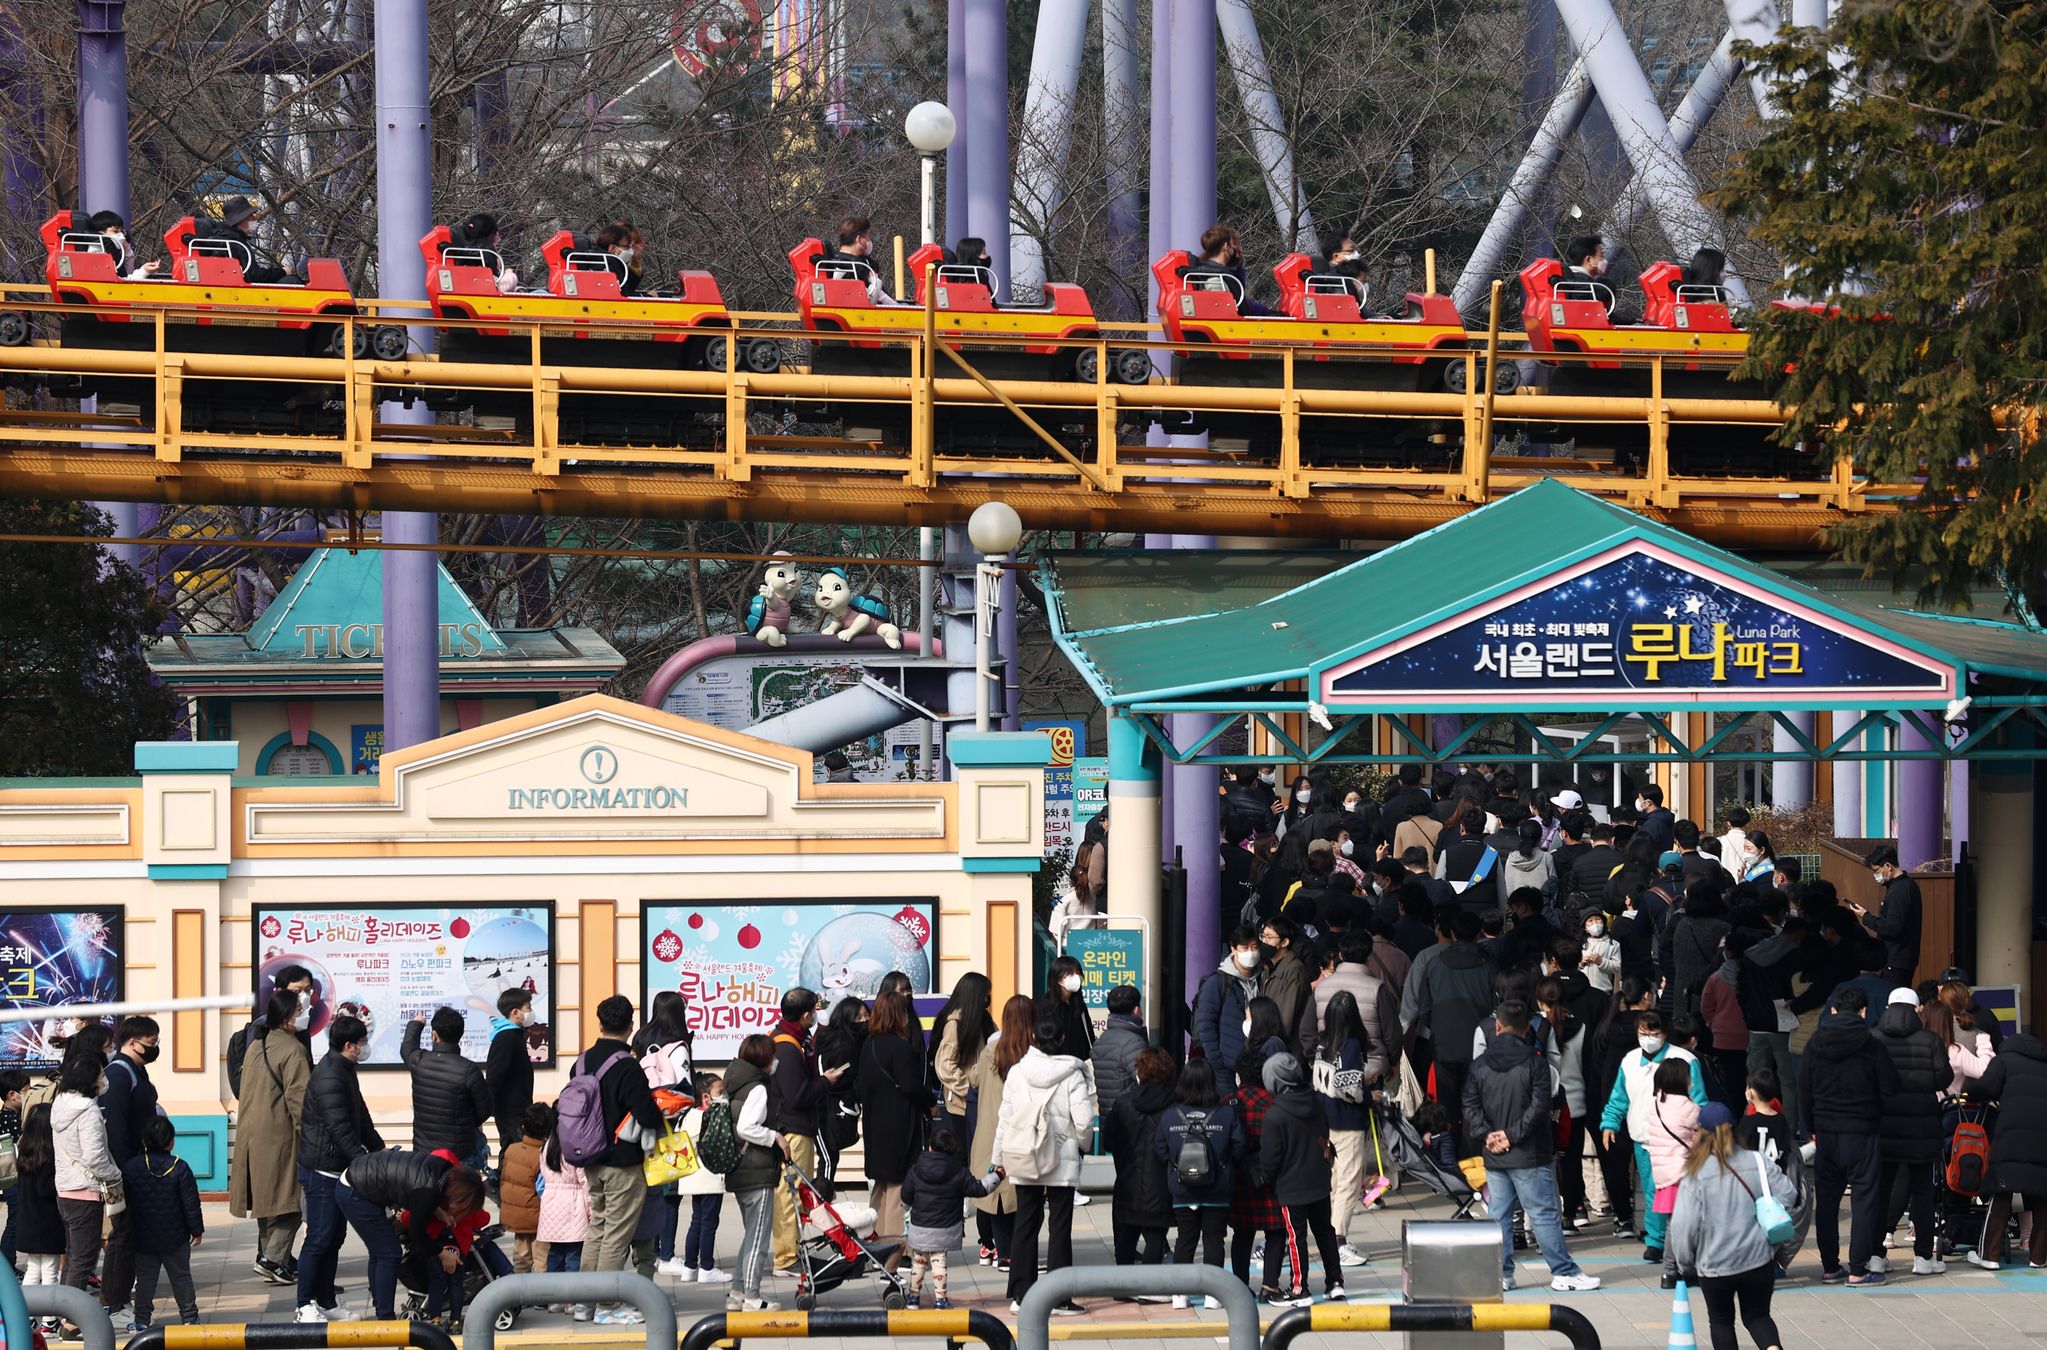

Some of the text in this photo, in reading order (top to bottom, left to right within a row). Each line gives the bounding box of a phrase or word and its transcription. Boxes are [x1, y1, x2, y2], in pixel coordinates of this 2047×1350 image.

[1485, 624, 1509, 638] 국내
[1574, 623, 1609, 637] 빛축제
[1736, 624, 1800, 639] Luna Park
[295, 623, 482, 658] TICTS
[1474, 642, 1615, 678] 서울랜드
[1626, 623, 1735, 681] 루나
[1734, 642, 1803, 679] 파크
[1044, 773, 1053, 783] 진
[1045, 784, 1058, 794] 럼
[1077, 789, 1106, 802] QR코
[508, 786, 688, 809] INFORMATION
[1061, 808, 1070, 818] 후
[287, 916, 442, 945] 루나 해피 홀리데이즈
[0, 945, 32, 965] 축제
[1082, 951, 1126, 968] 온라인
[357, 959, 389, 969] 루나파크
[400, 959, 424, 969] 스노우
[703, 962, 763, 974] 서울랜드 겨울축제
[0, 968, 39, 999] 크
[1108, 971, 1135, 986] 티켓
[678, 971, 778, 1005] 루나 해피
[686, 1005, 782, 1031] 리데이즈
[1092, 1020, 1106, 1031] 라인
